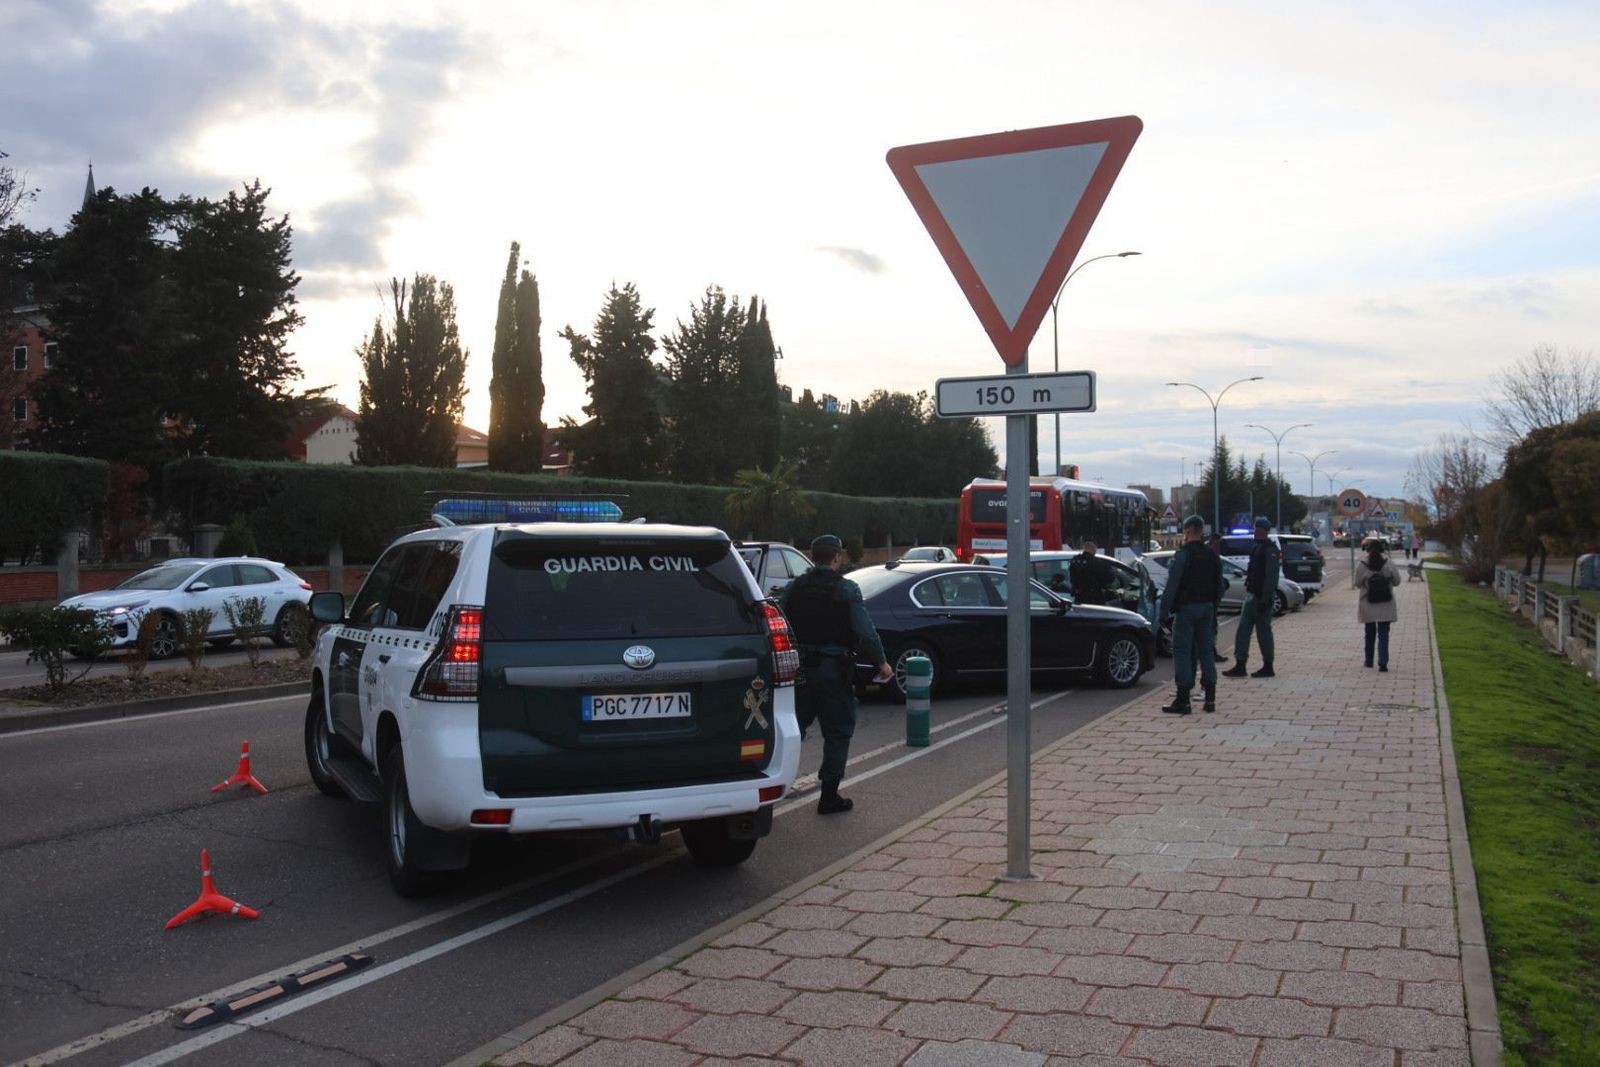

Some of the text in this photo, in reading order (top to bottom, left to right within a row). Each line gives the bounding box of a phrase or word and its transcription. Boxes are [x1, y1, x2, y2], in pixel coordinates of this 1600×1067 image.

[976, 386, 1051, 405] 150 m
[1344, 498, 1361, 508] 40
[544, 556, 699, 574] GUARDIA CIVIL
[580, 672, 625, 685] LAND
[593, 695, 689, 716] PGC 7717 N
